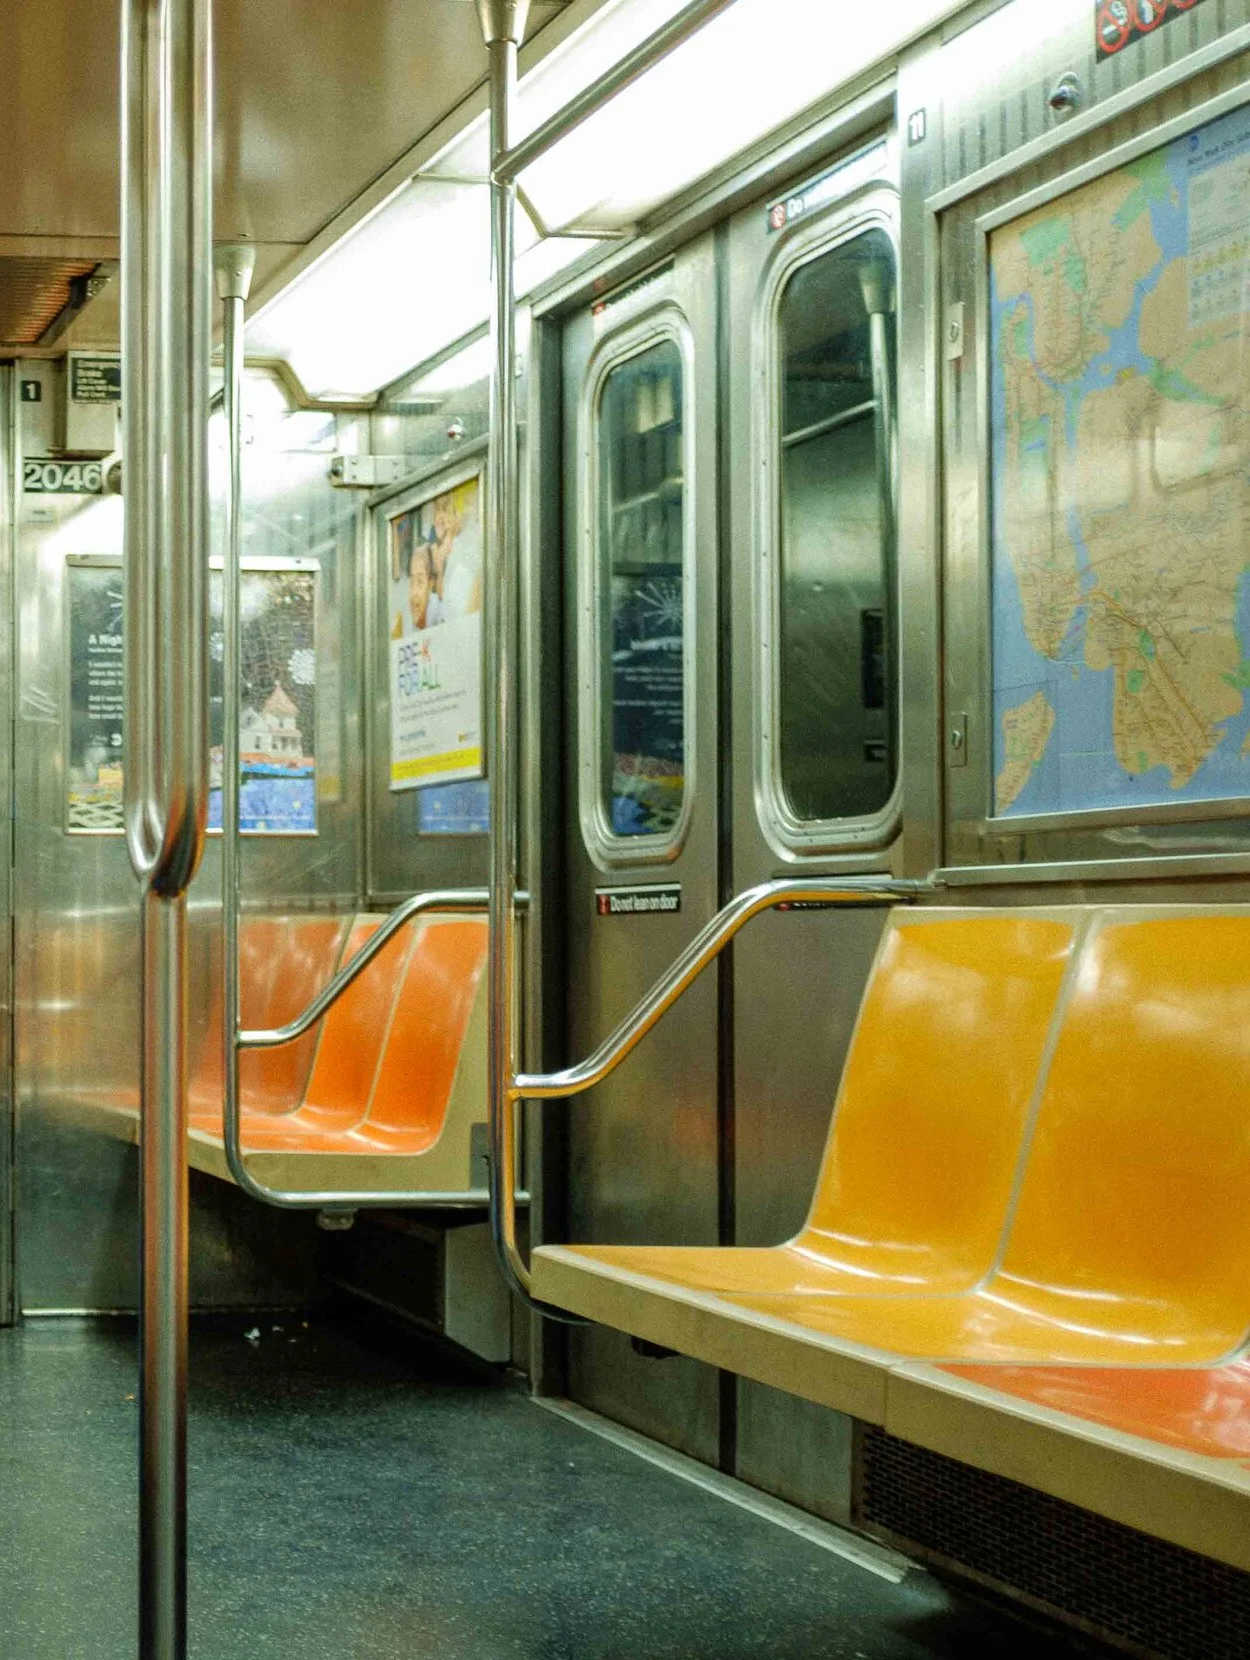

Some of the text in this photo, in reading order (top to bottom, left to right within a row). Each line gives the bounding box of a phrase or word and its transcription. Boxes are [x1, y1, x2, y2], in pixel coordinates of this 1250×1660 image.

[26, 383, 36, 400] 1
[24, 463, 102, 491] 2046
[610, 893, 678, 912] Do not lean on door
